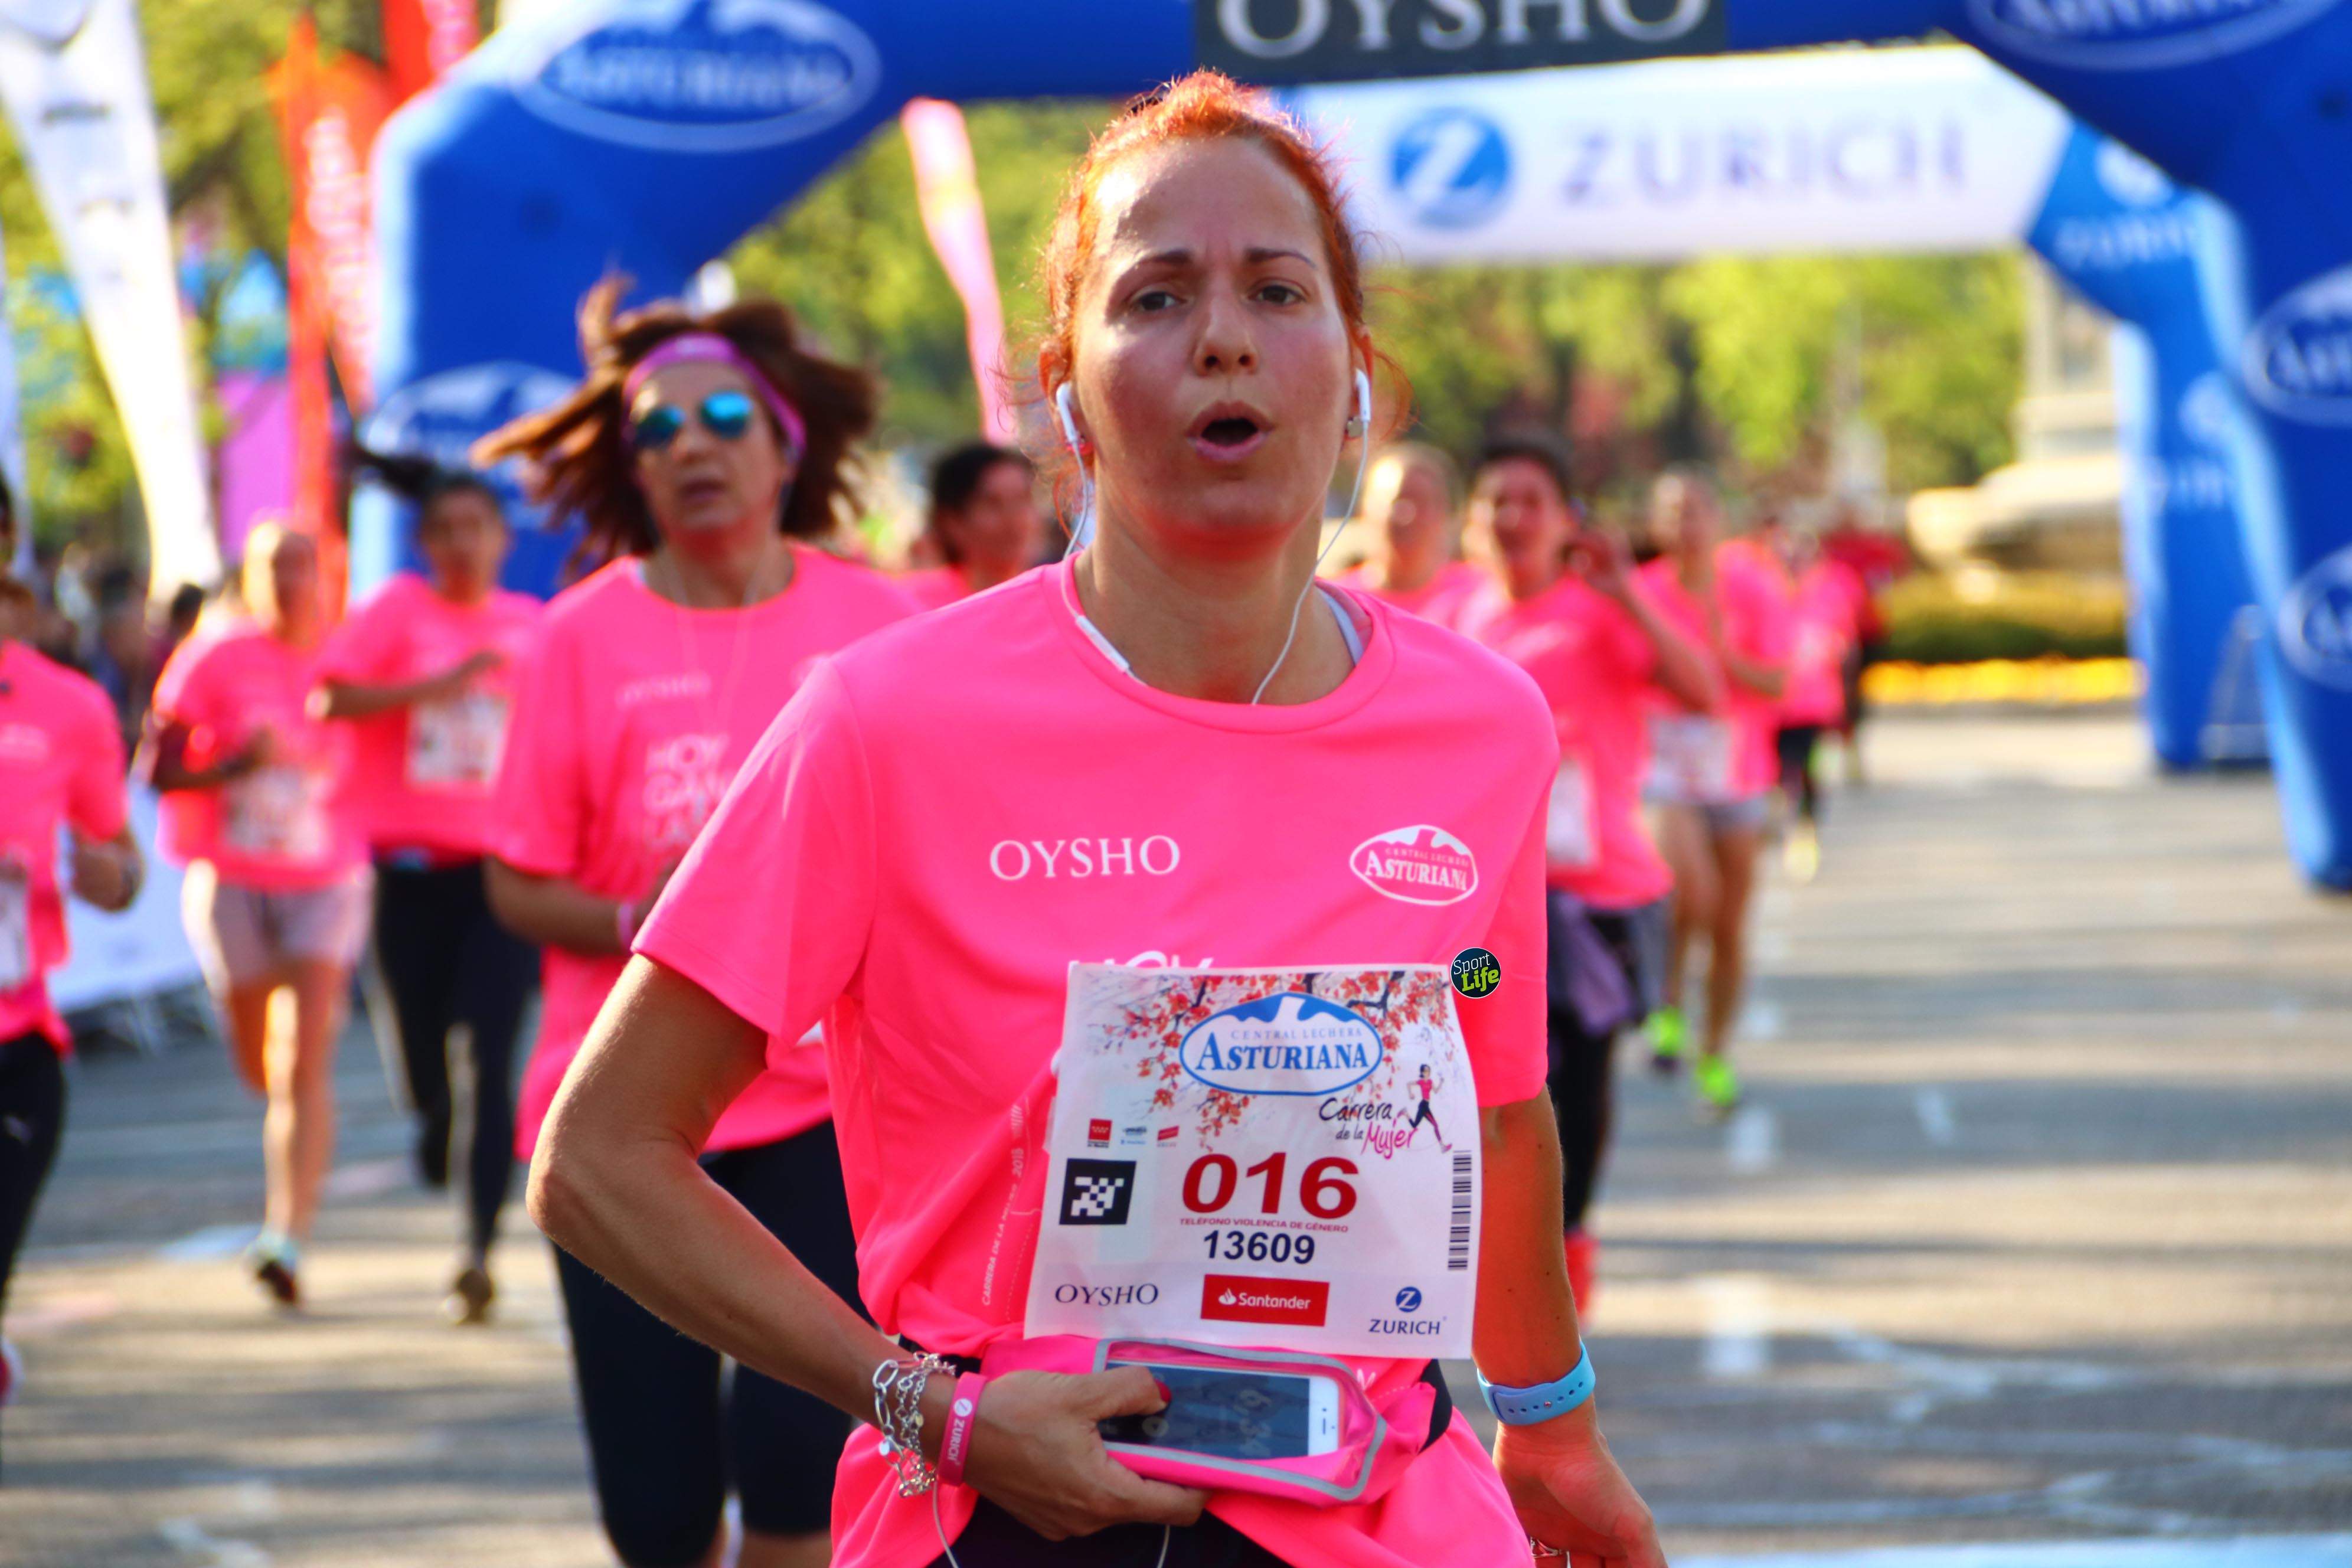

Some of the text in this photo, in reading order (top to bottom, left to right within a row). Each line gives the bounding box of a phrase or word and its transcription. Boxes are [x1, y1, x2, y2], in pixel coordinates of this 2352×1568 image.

[1556, 122, 1967, 204] ZURICH
[989, 834, 1180, 881] OYSHO
[1364, 850, 1467, 891] ASTURIANA
[1195, 1031, 1369, 1071] ASTURIANA
[1231, 1028, 1363, 1040] CENTRAL LECHERA
[1319, 1097, 1392, 1121] Carrera
[1336, 1118, 1418, 1160] de la Mujer
[1182, 1152, 1359, 1220] 016
[1180, 1216, 1348, 1233] TELÉFONO VIOLENCIA DE GÉNERO
[1203, 1229, 1315, 1265] 13609
[981, 1256, 997, 1306] CARRERA
[1054, 1282, 1159, 1307] OYSHO
[1238, 1292, 1311, 1310] Santander
[1368, 1318, 1442, 1335] ZURICH
[947, 1418, 965, 1461] ZURICH
